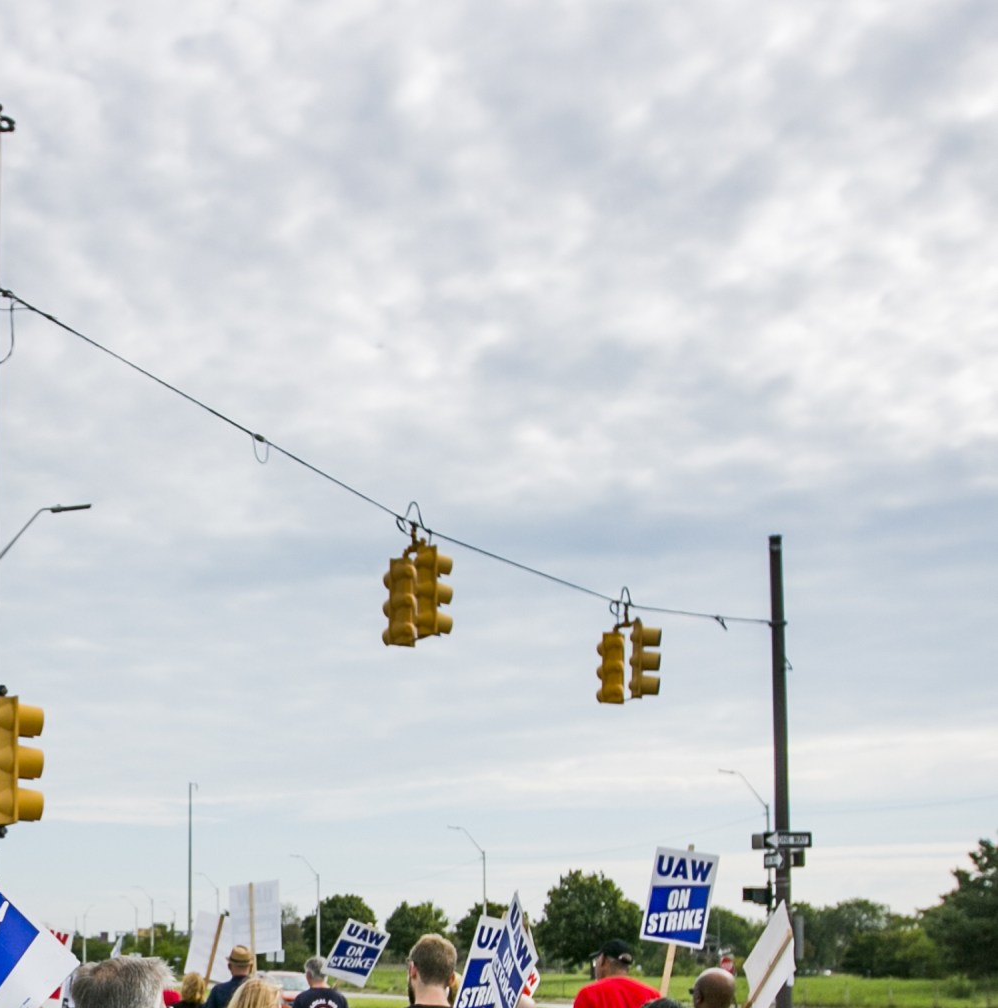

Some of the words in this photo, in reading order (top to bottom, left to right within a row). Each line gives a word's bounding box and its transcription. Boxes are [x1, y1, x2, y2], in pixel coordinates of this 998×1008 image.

[657, 855, 713, 882] UAW
[667, 888, 691, 910] ON
[647, 908, 704, 934] STRIKE
[347, 923, 385, 947] UAW
[476, 925, 502, 950] UA
[510, 901, 533, 972] UAW
[329, 956, 375, 969] STRIKE
[346, 945, 366, 957] ON
[503, 948, 515, 978] ON
[479, 962, 492, 985] O
[458, 984, 495, 1008] STRI
